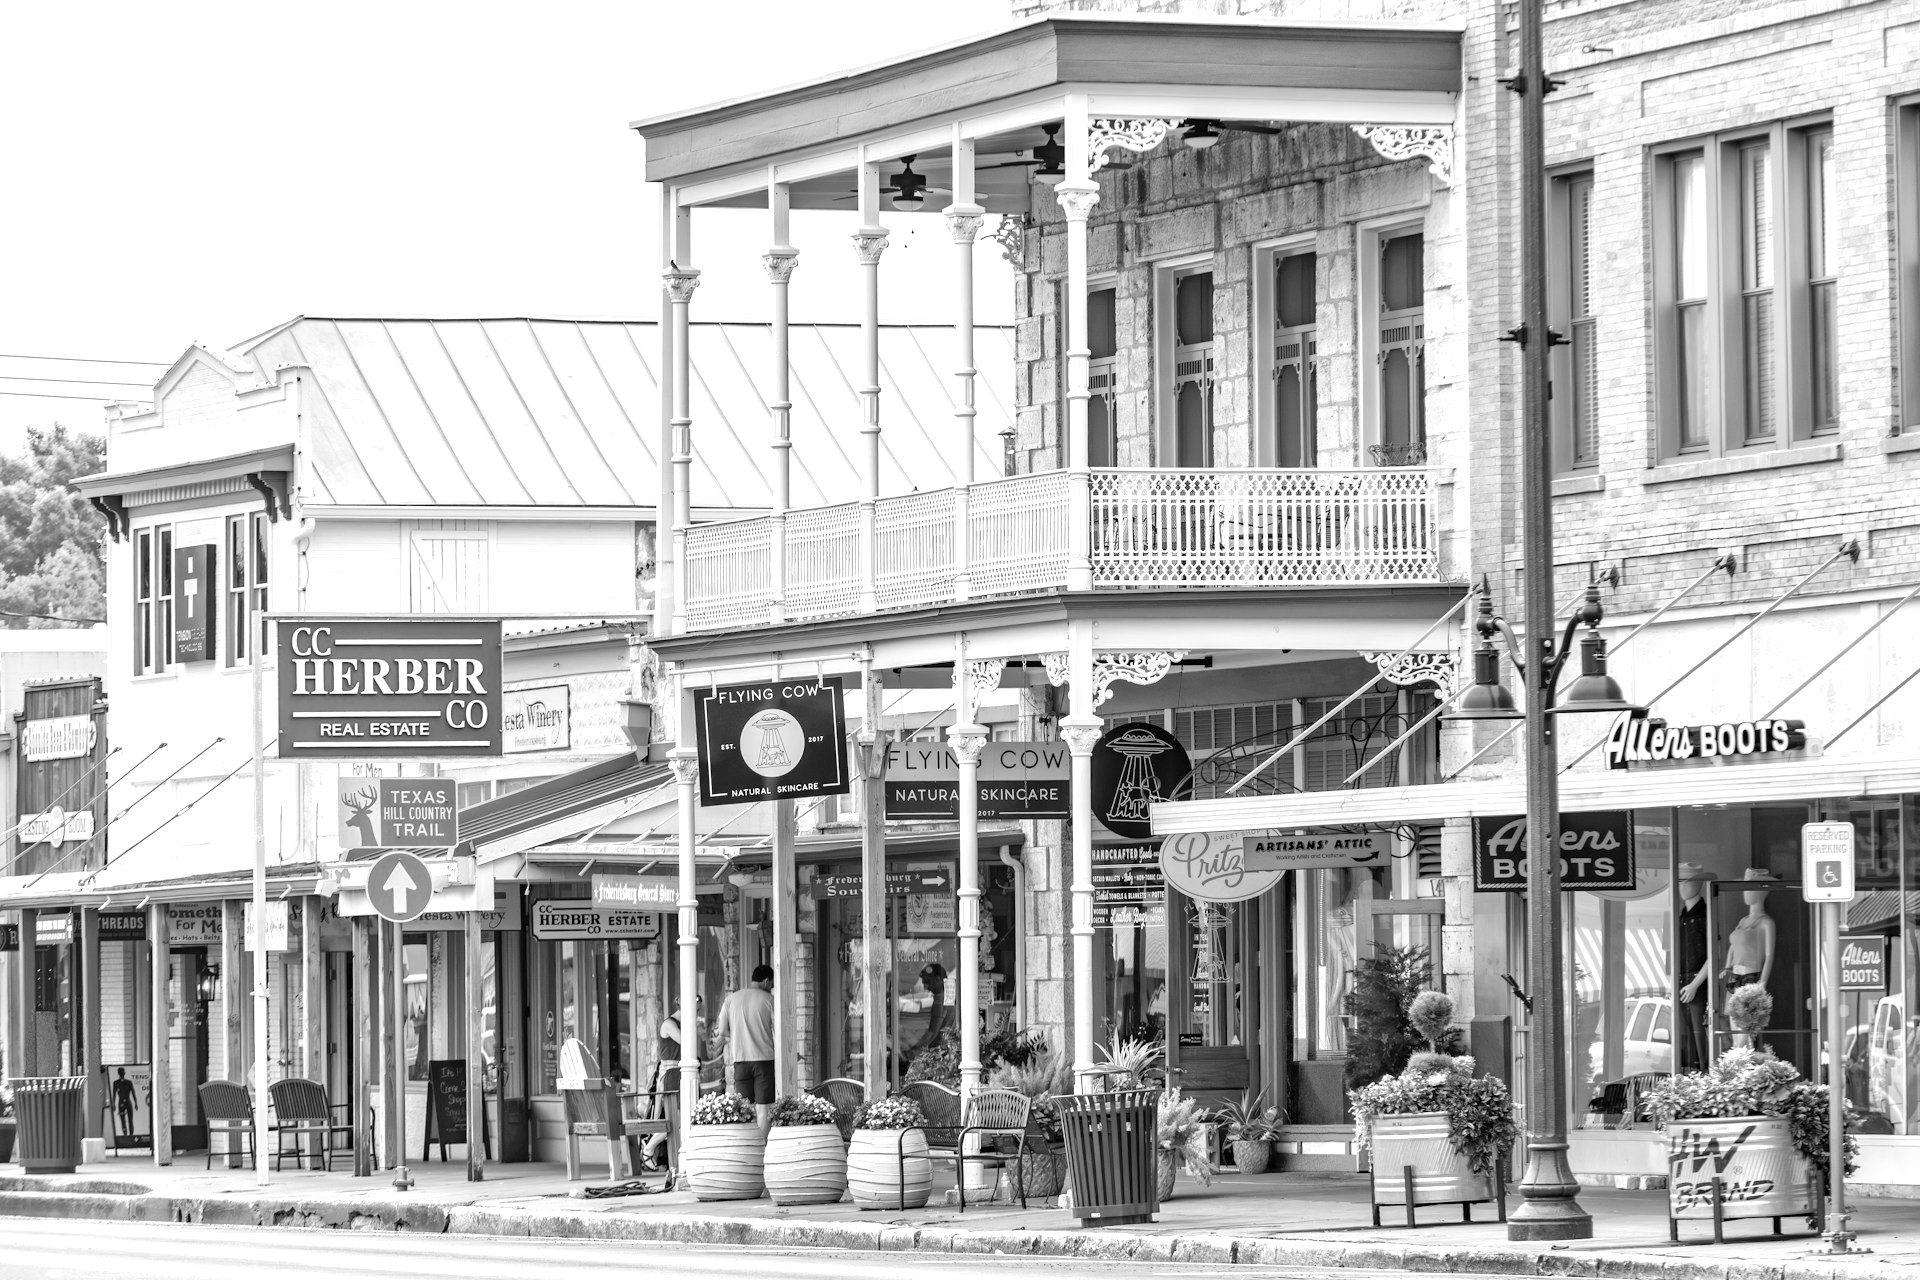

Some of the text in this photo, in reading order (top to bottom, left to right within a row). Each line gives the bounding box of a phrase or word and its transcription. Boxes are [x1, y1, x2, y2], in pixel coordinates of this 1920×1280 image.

[292, 627, 331, 656] CC
[292, 658, 488, 695] HERBER
[718, 683, 819, 704] FLYING COW
[446, 700, 488, 729] CO
[320, 723, 430, 736] REAL ESTATE
[505, 701, 563, 744] esta Winery
[1603, 710, 1789, 769] Allens BOOTS
[888, 750, 1064, 770] FLYIN COW
[731, 782, 819, 797] NATURAL SKINCARE
[895, 788, 1059, 801] NATURA SKINCARE
[390, 790, 446, 804] TEXAS
[384, 806, 453, 820] HILL COUNTRY
[393, 823, 445, 837] TRAIL
[1213, 832, 1240, 842] SWEET
[1808, 831, 1849, 841] RESERVED
[1487, 818, 1621, 857] Aens
[1255, 838, 1374, 852] ARTISANS' ATTIC
[1810, 844, 1847, 853] PARKING
[1092, 848, 1138, 860] HANDCRAFTED
[1172, 832, 1244, 888] Pritz
[1275, 853, 1294, 862] Working
[1493, 857, 1615, 879] BTS
[827, 884, 911, 897] Souirs
[539, 905, 553, 913] CC
[1109, 906, 1132, 923] Leather
[176, 920, 223, 933] For Me
[539, 914, 601, 926] HERBER
[608, 916, 651, 926] ESTATE
[587, 925, 601, 934] CO
[1841, 942, 1881, 968] Allens
[1842, 969, 1880, 982] BOOTS
[1675, 1179, 1775, 1214] BRAND
